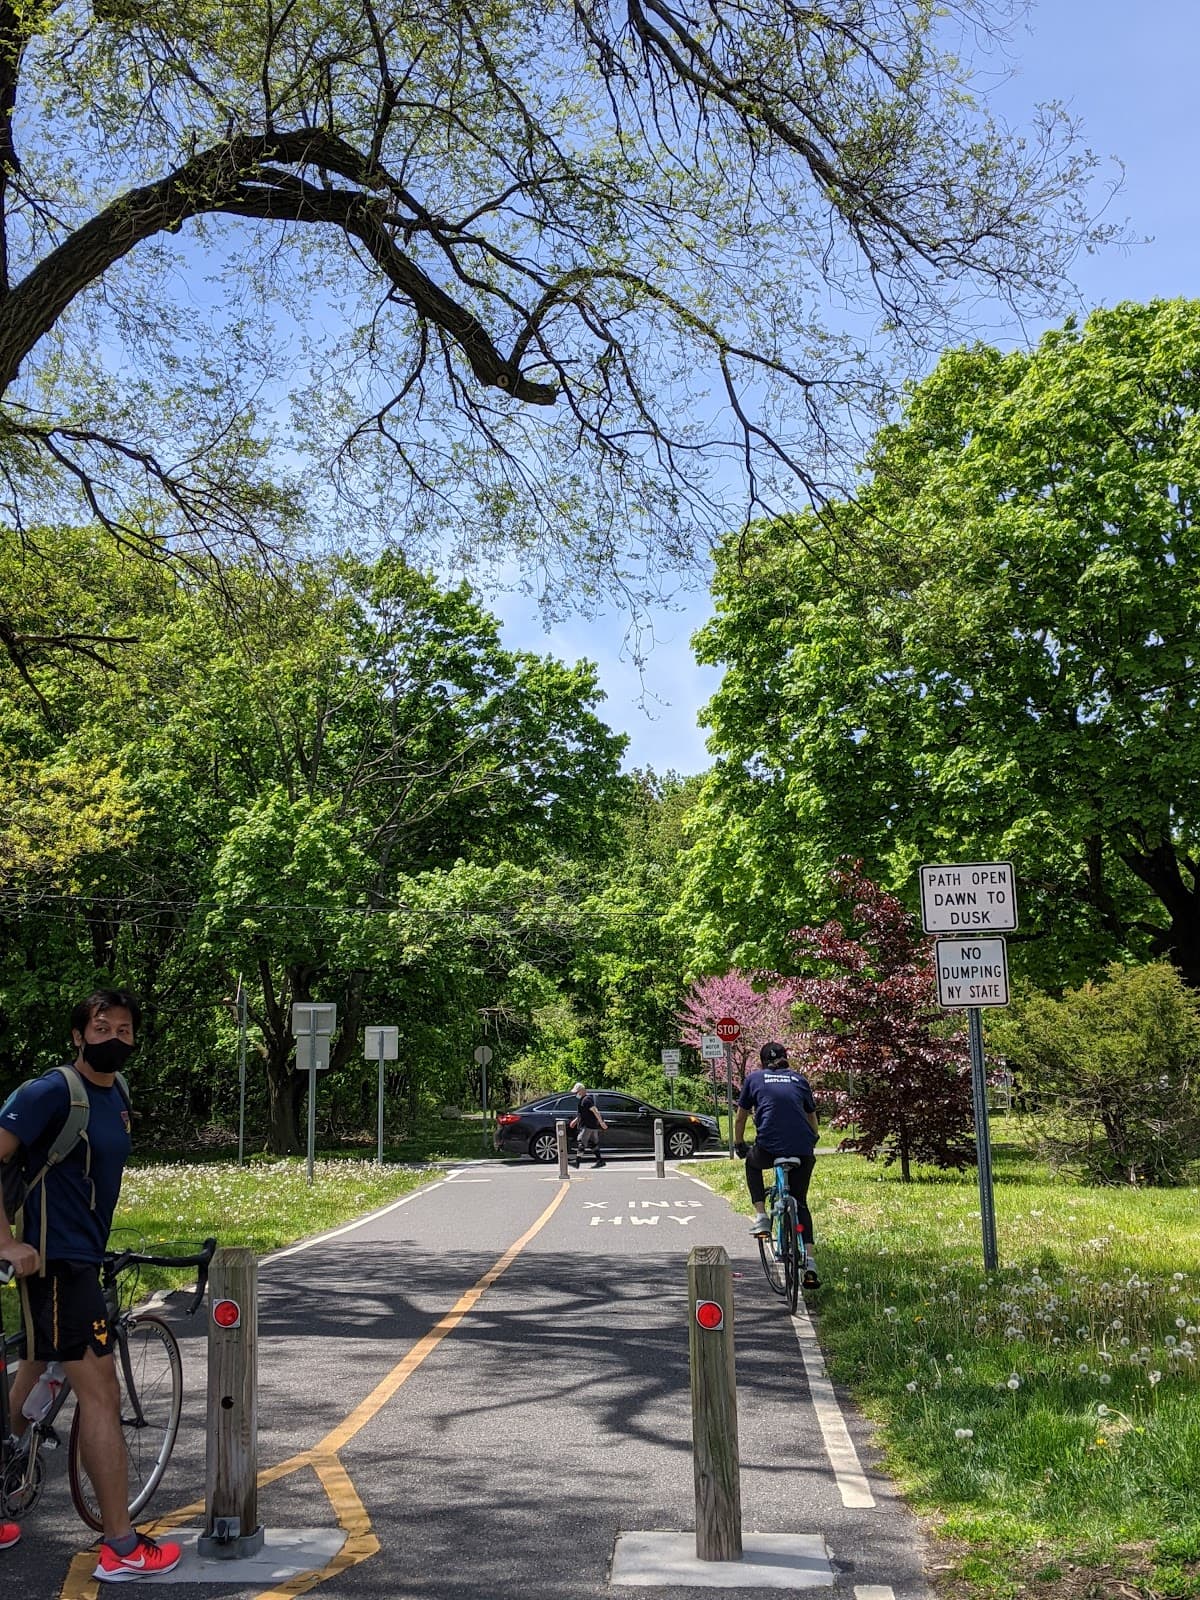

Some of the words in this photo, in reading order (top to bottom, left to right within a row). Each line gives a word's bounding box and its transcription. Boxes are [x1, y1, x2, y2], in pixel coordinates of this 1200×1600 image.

[928, 873, 961, 887] PATH
[971, 871, 1007, 885] OPEN
[934, 892, 977, 906] DAWN
[986, 891, 1006, 904] TO
[950, 911, 992, 925] DUSK
[961, 947, 981, 960] NO
[942, 965, 1002, 980] DUMPING
[948, 985, 962, 999] NY
[969, 984, 1000, 998] STATE
[717, 1024, 740, 1036] STOP
[582, 1201, 609, 1209] X
[628, 1200, 704, 1208] ING
[589, 1215, 697, 1226] HWY
